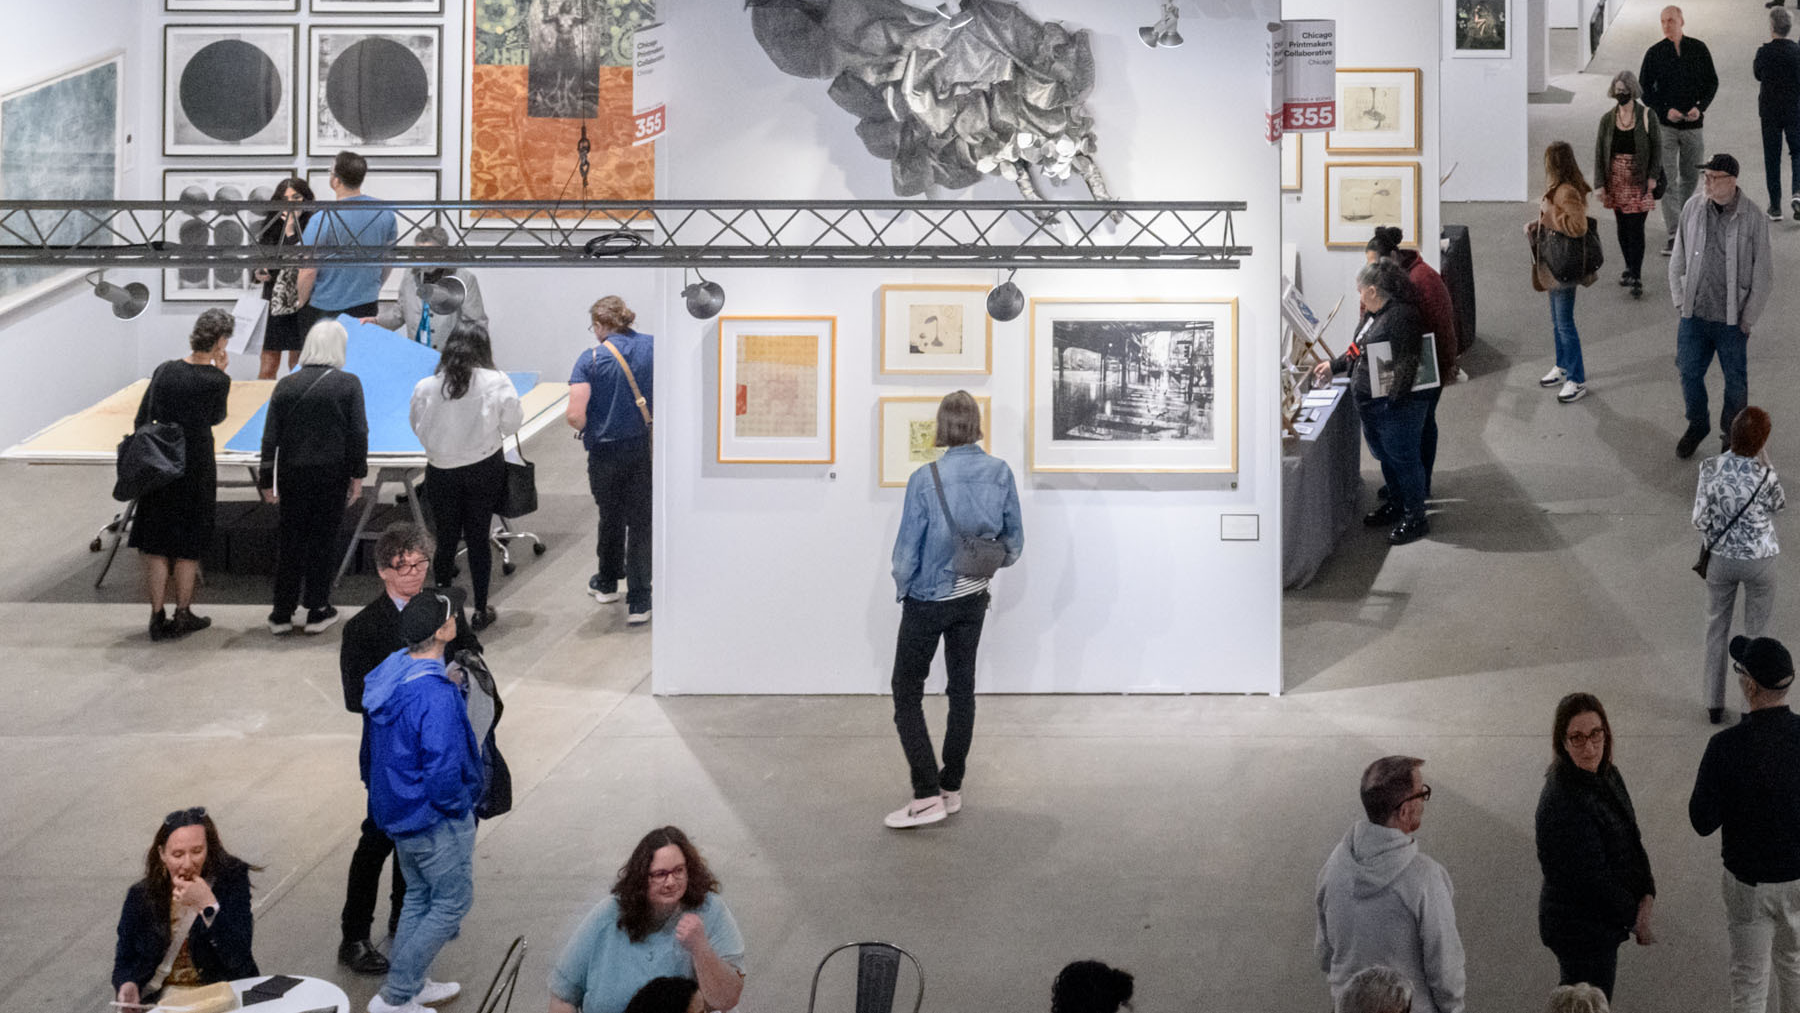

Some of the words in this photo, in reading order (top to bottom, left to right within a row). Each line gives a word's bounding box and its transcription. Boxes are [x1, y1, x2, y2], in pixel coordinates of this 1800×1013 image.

[1302, 32, 1333, 40] Chicago
[1288, 40, 1333, 49] Printmakers
[1283, 49, 1333, 58] Collaborative
[1290, 106, 1333, 126] 355
[635, 113, 662, 138] 355
